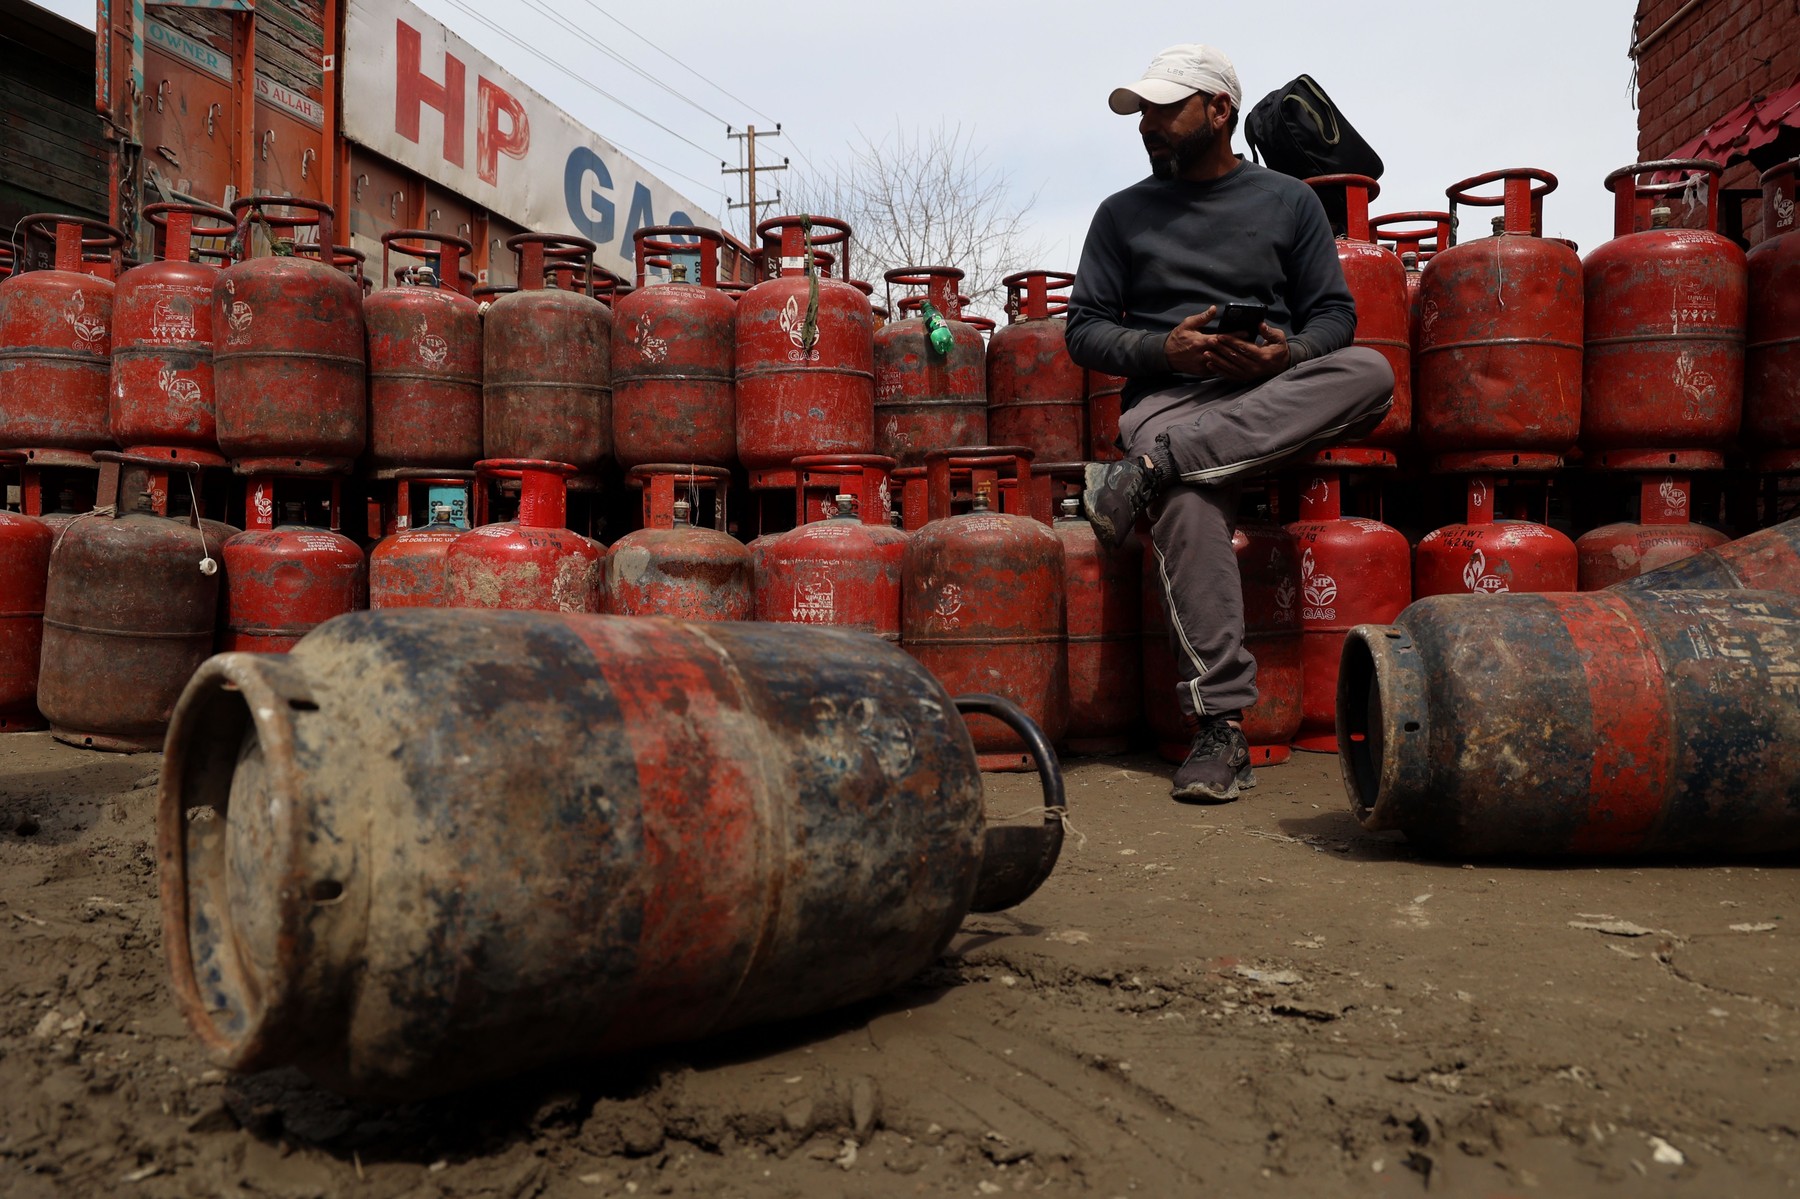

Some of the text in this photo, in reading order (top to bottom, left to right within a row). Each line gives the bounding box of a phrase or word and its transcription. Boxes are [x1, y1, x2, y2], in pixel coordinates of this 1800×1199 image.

[150, 23, 219, 69] OWNER
[256, 78, 312, 116] IS ALLAH
[395, 18, 530, 187] HP
[788, 349, 820, 361] GAS
[176, 382, 194, 391] HP
[451, 500, 465, 522] 15.8
[1312, 578, 1331, 588] HP
[1482, 578, 1502, 589] HP
[1302, 607, 1336, 620] GAS
